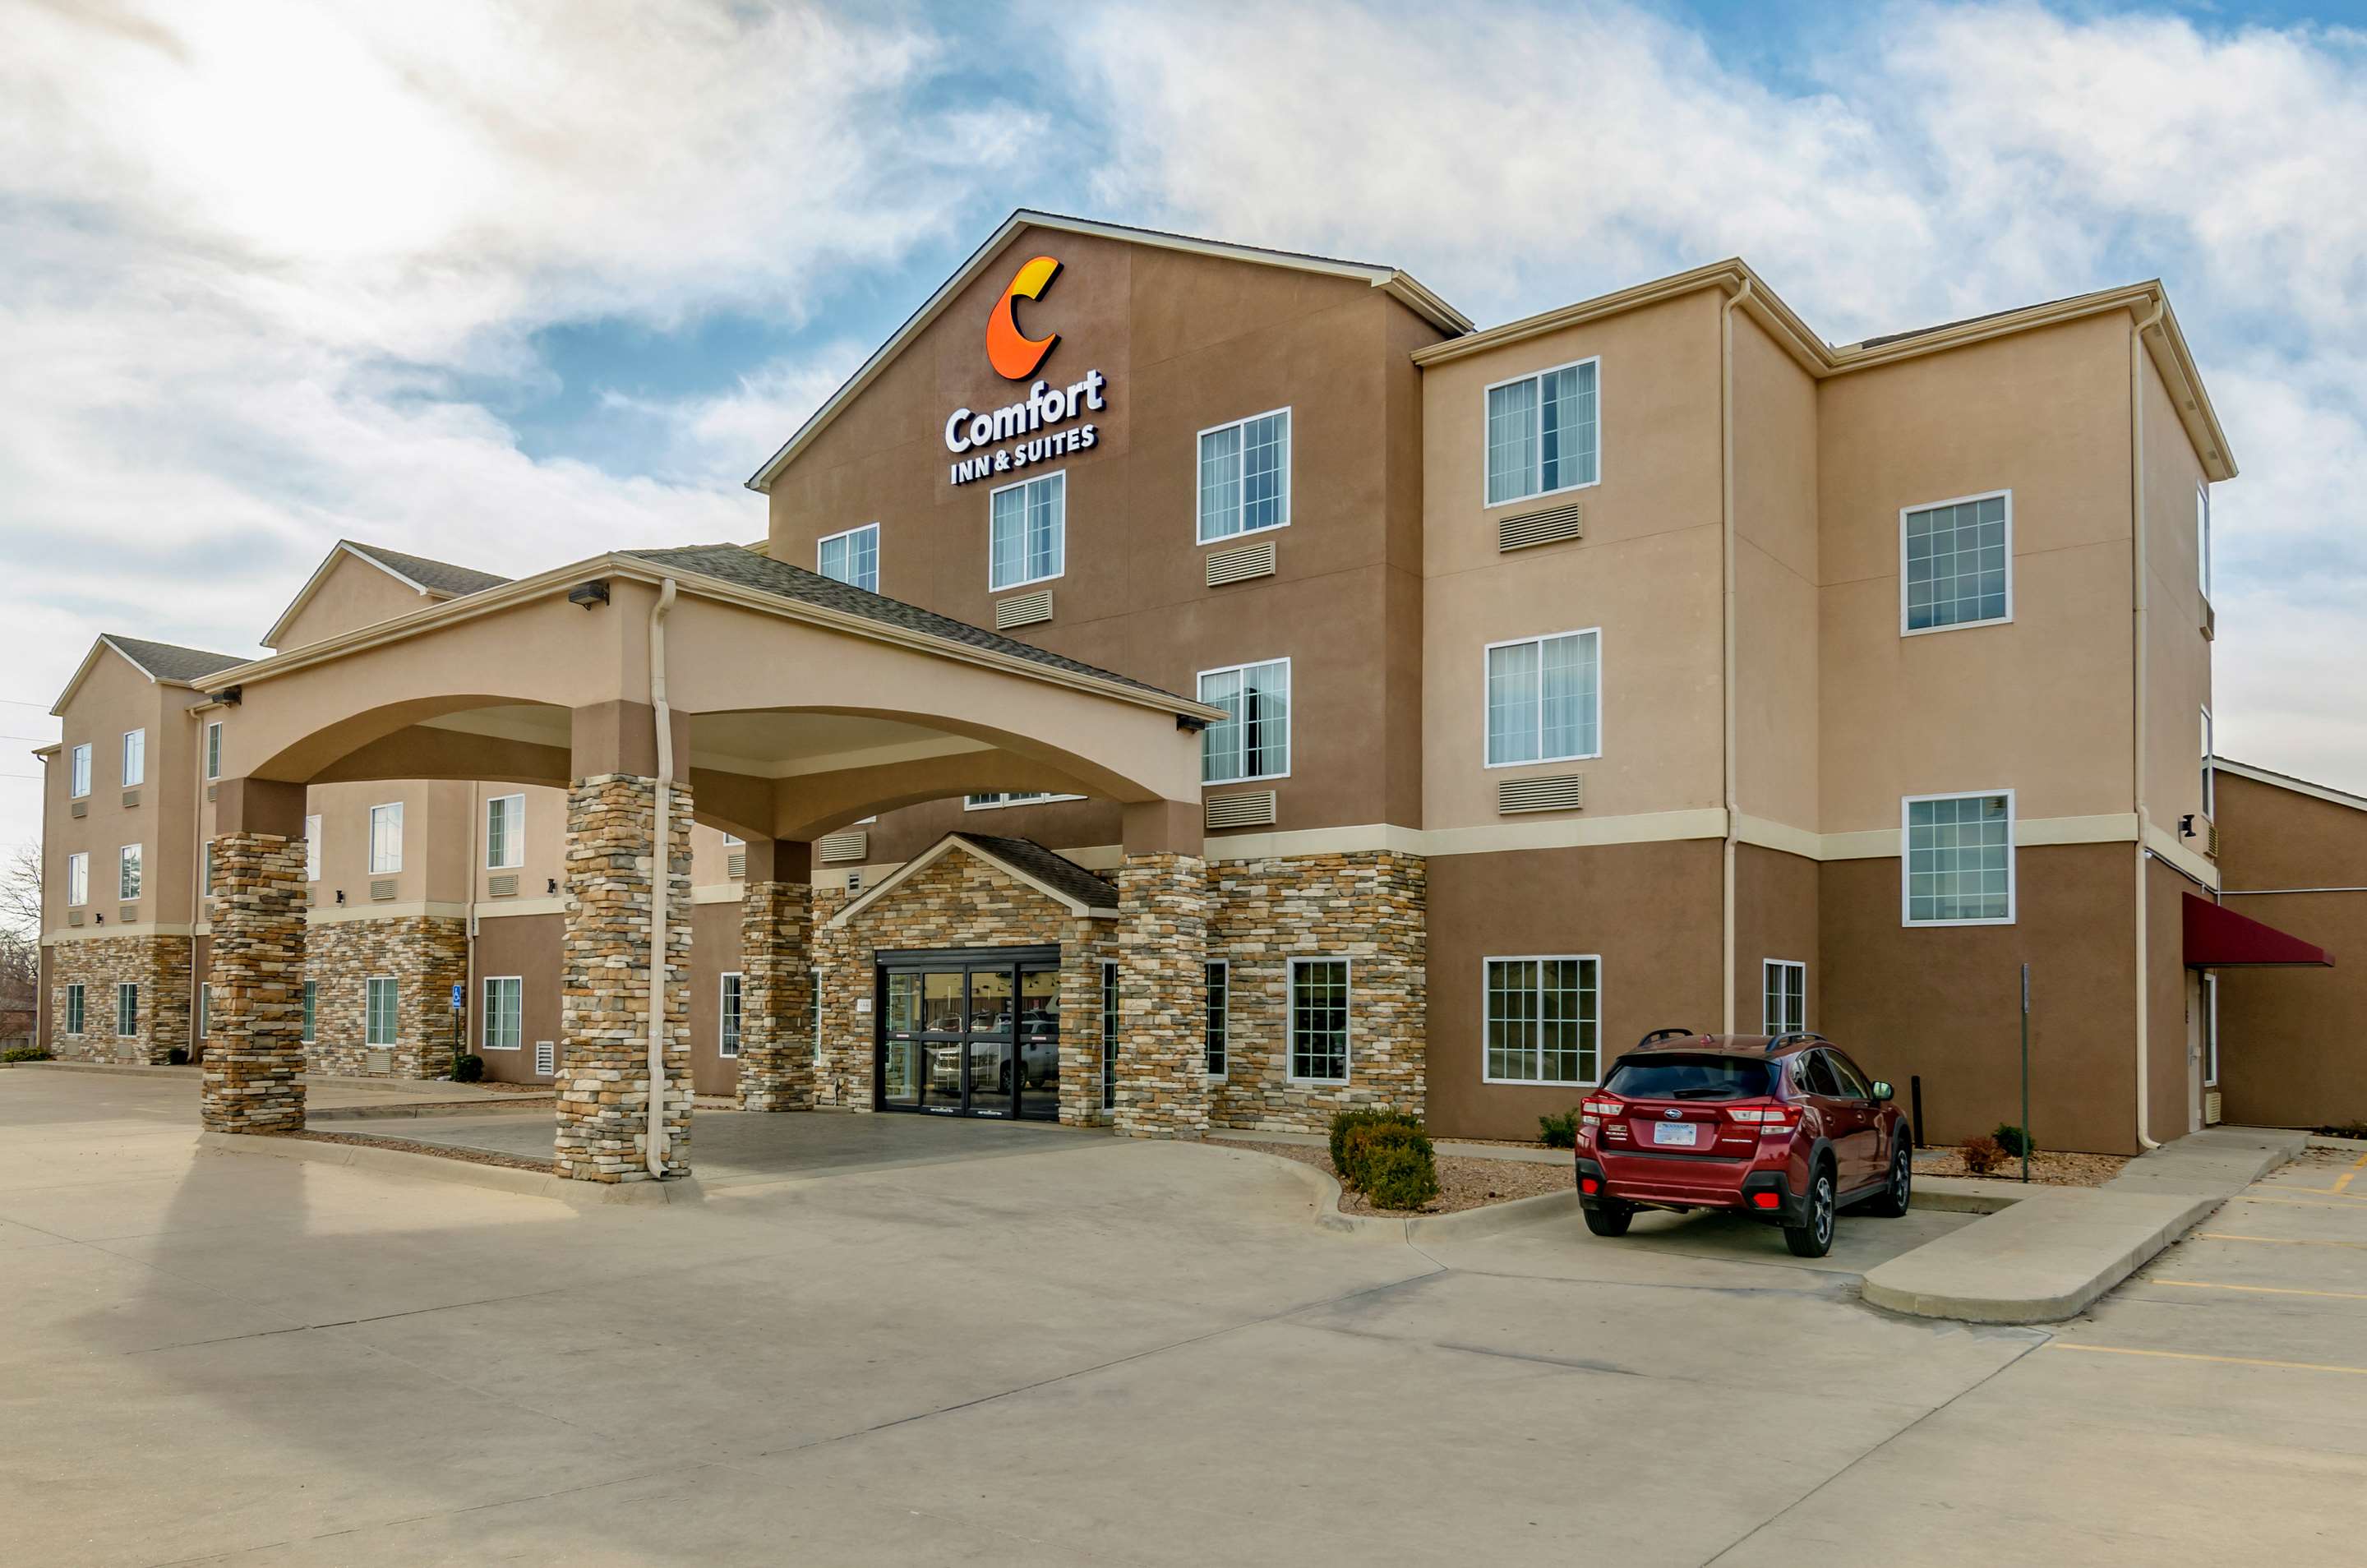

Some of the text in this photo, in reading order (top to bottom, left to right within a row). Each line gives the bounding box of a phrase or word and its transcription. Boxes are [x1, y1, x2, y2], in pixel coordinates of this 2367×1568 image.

[945, 370, 1105, 453] Comfort
[951, 424, 1096, 485] INN & SUITES
